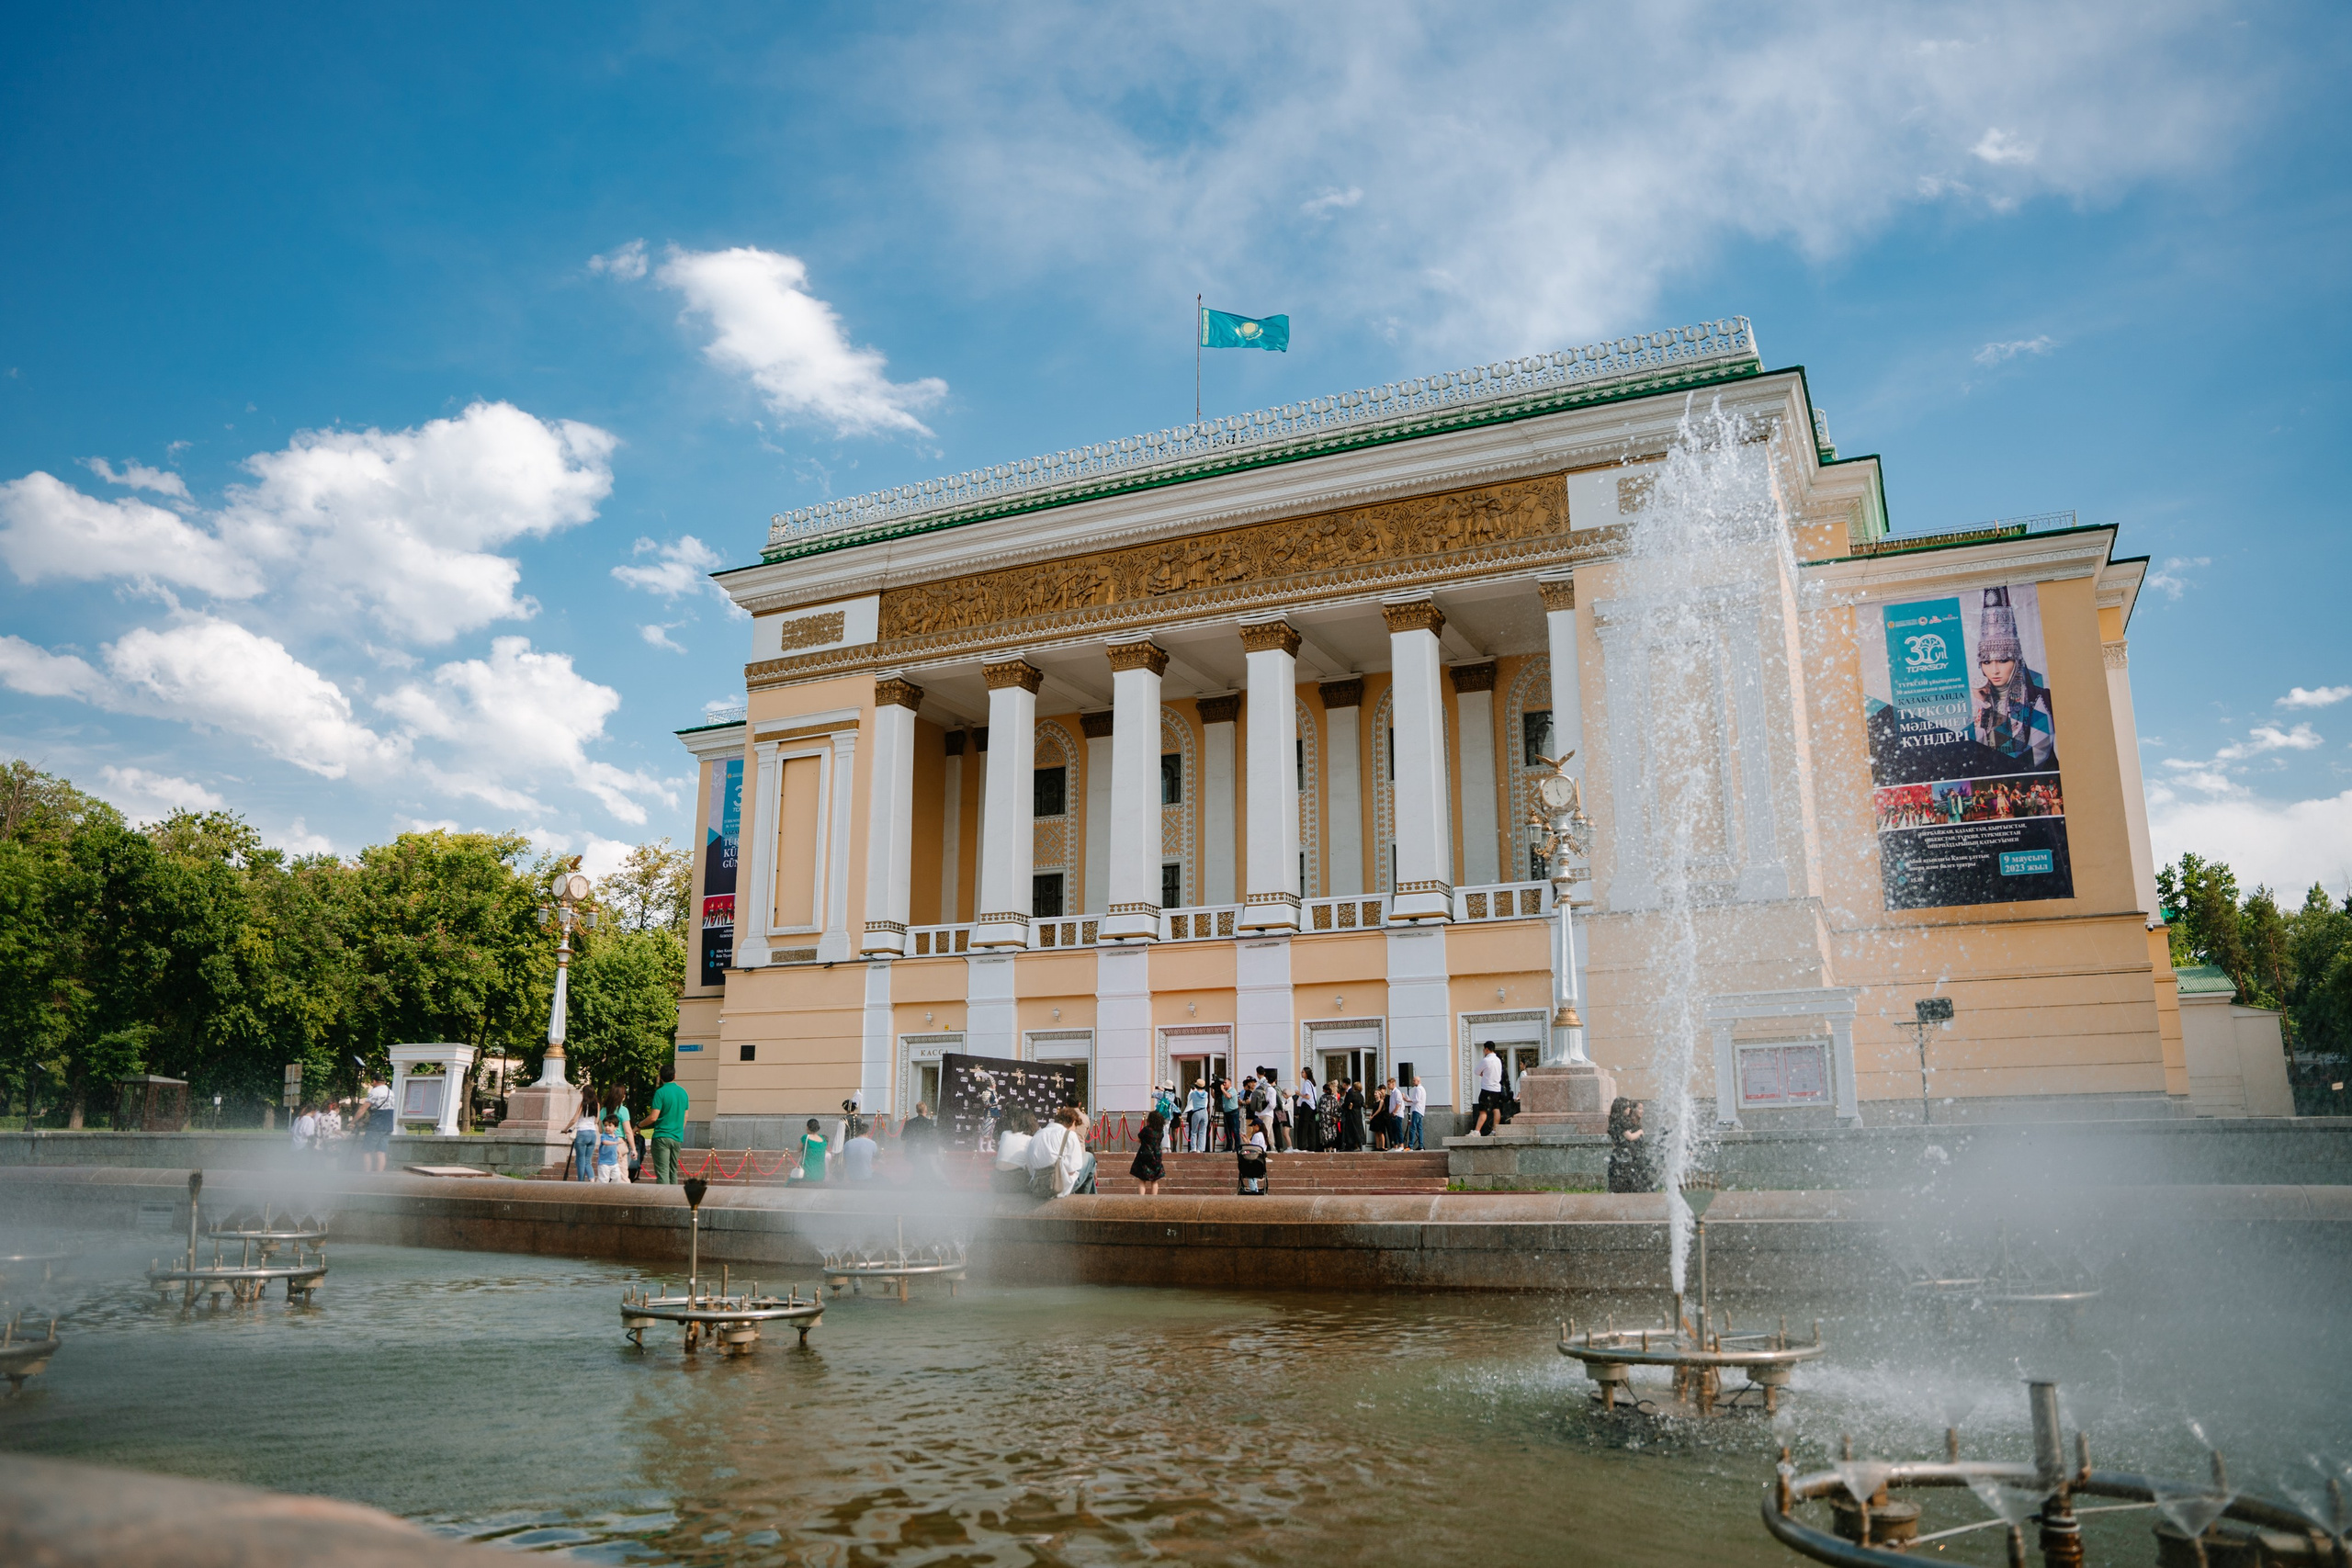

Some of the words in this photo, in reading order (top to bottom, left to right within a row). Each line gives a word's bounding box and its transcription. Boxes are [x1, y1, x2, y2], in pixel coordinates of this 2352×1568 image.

[1898, 692, 1964, 705] ҚАЗАҚСТАНДА
[1897, 700, 1968, 720] ТҮРКСОЙ
[1899, 716, 1969, 733] МӘДЕНИЕТ
[1901, 729, 1970, 748] КҮНДЕРІ
[2004, 855, 2009, 863] 9
[2011, 854, 2048, 863] маусым
[2005, 863, 2025, 873] 2023
[2027, 863, 2048, 872] жыл
[921, 1048, 949, 1056] КАССА
